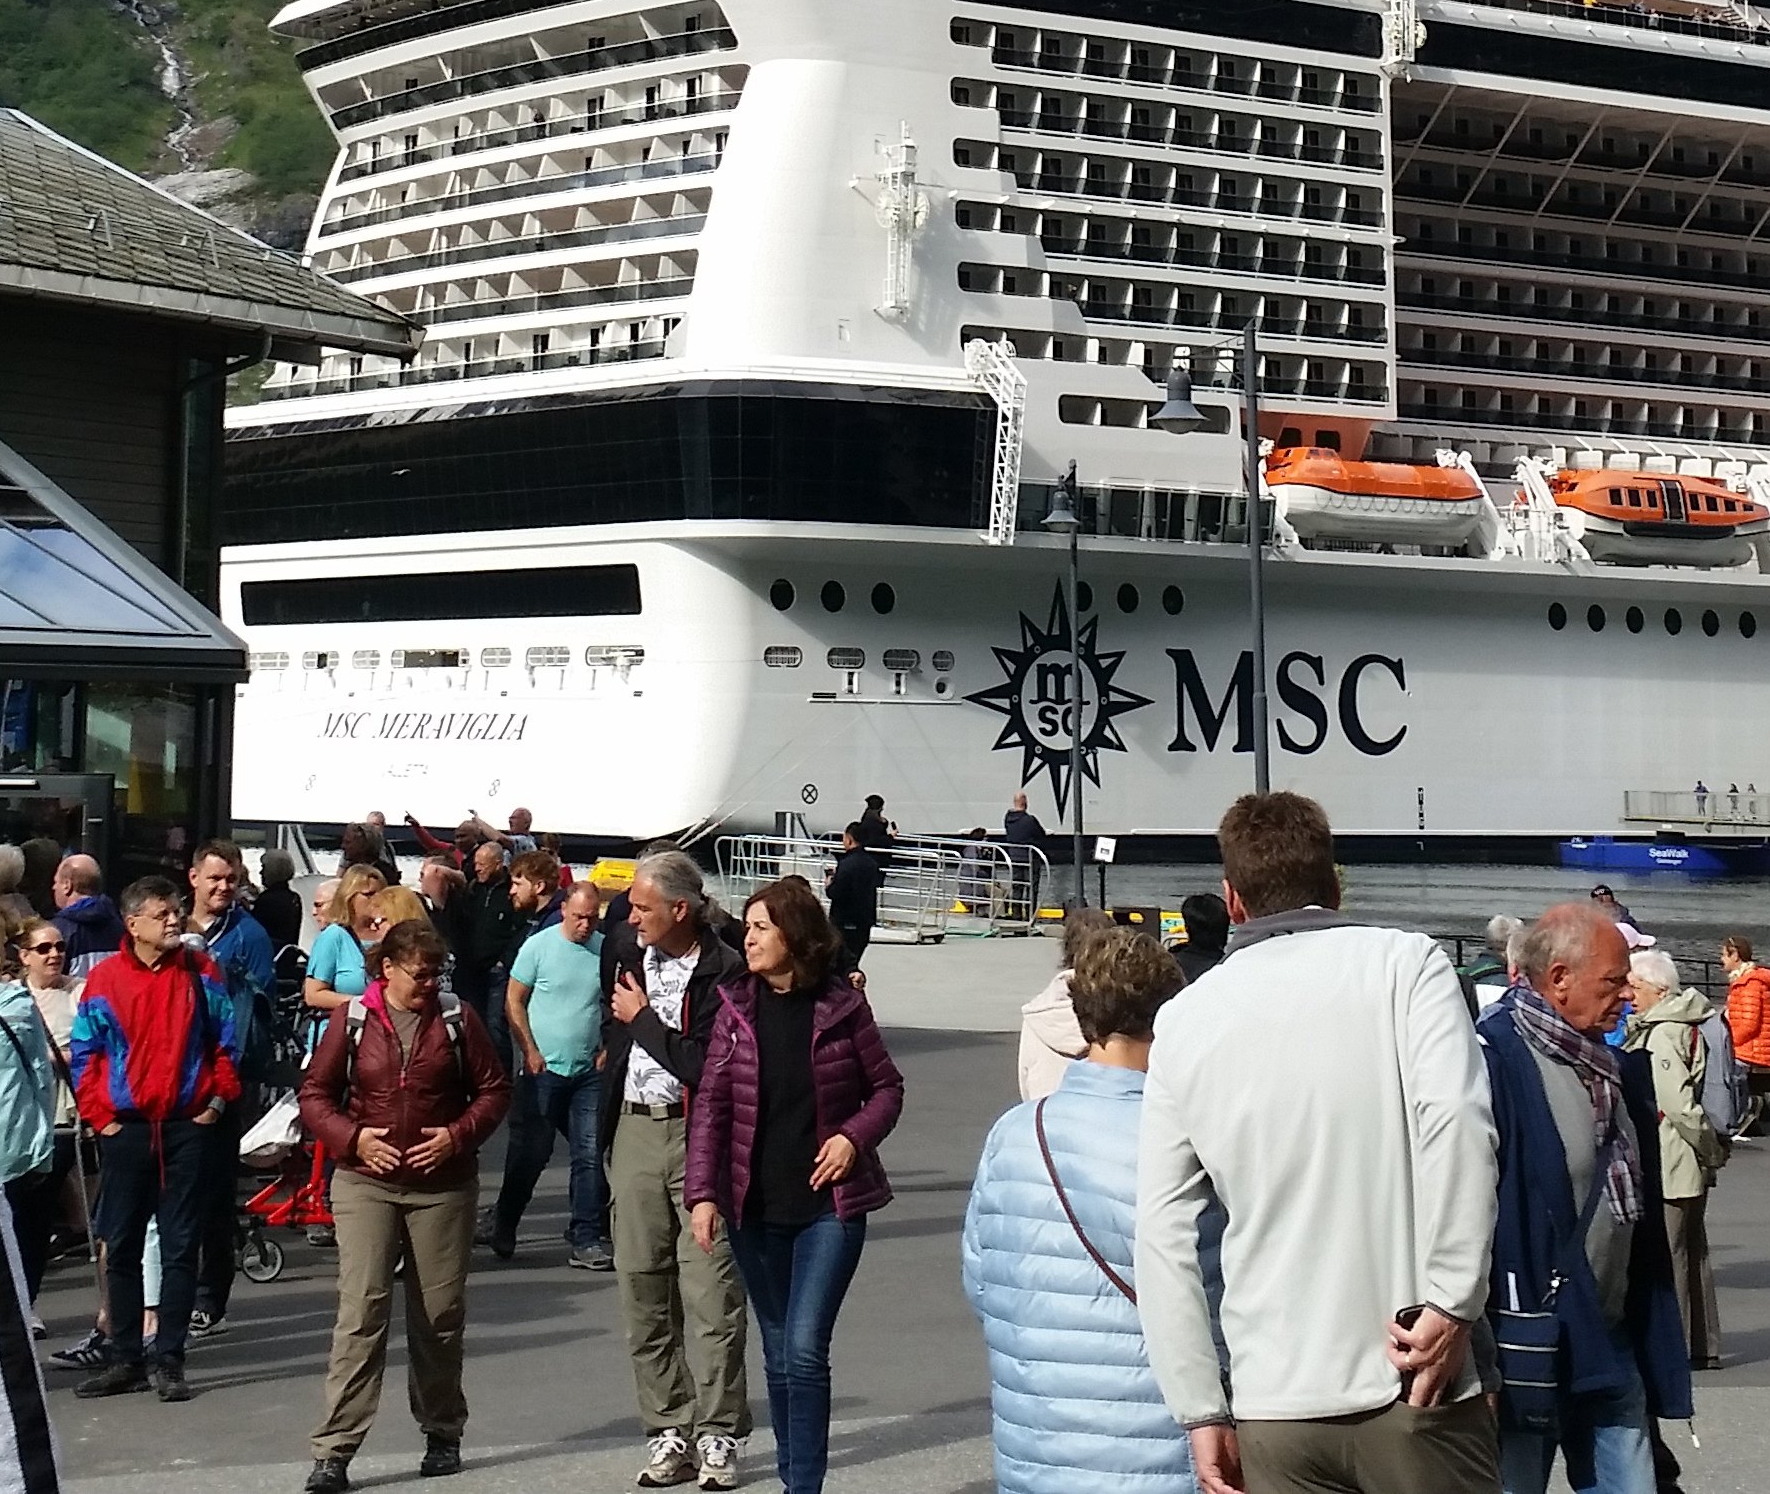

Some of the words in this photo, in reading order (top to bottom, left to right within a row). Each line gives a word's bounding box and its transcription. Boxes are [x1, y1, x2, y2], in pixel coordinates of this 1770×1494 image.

[1165, 648, 1408, 757] MSC
[317, 711, 371, 739] MSC
[371, 711, 529, 741] MERAVIGLIA
[1648, 847, 1690, 859] SeaWalk
